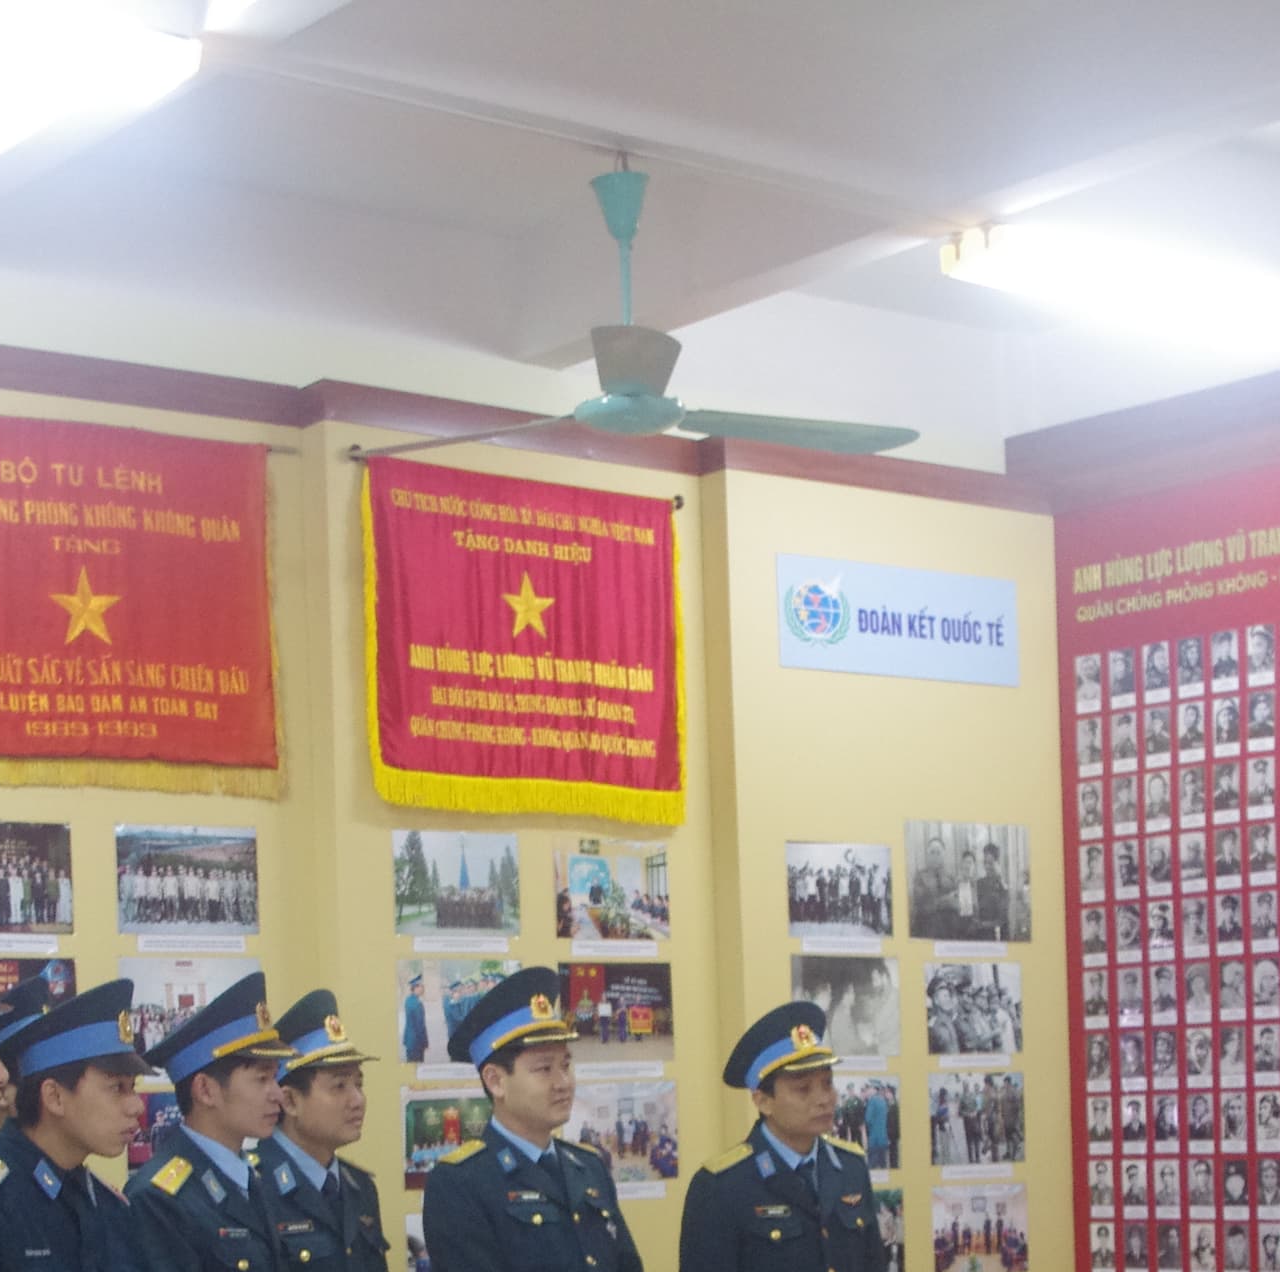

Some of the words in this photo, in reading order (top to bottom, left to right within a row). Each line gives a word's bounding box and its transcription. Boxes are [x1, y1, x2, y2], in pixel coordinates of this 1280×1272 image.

[0, 456, 38, 489] BỘ
[97, 463, 163, 495] LỆNH
[453, 528, 500, 552] TẶNG
[504, 537, 549, 558] DANH
[553, 542, 593, 566] HIỆU
[1073, 563, 1102, 595] ANH
[1216, 570, 1269, 595] KHÔNG
[858, 604, 903, 638] ĐOÀN
[908, 605, 936, 640] KẾT
[941, 611, 983, 645] QUỐC
[987, 615, 1005, 647] TẾ
[410, 643, 435, 671] ANH
[554, 657, 593, 684] TRANG
[594, 659, 627, 689] NHÂN
[628, 663, 654, 692] DÂN
